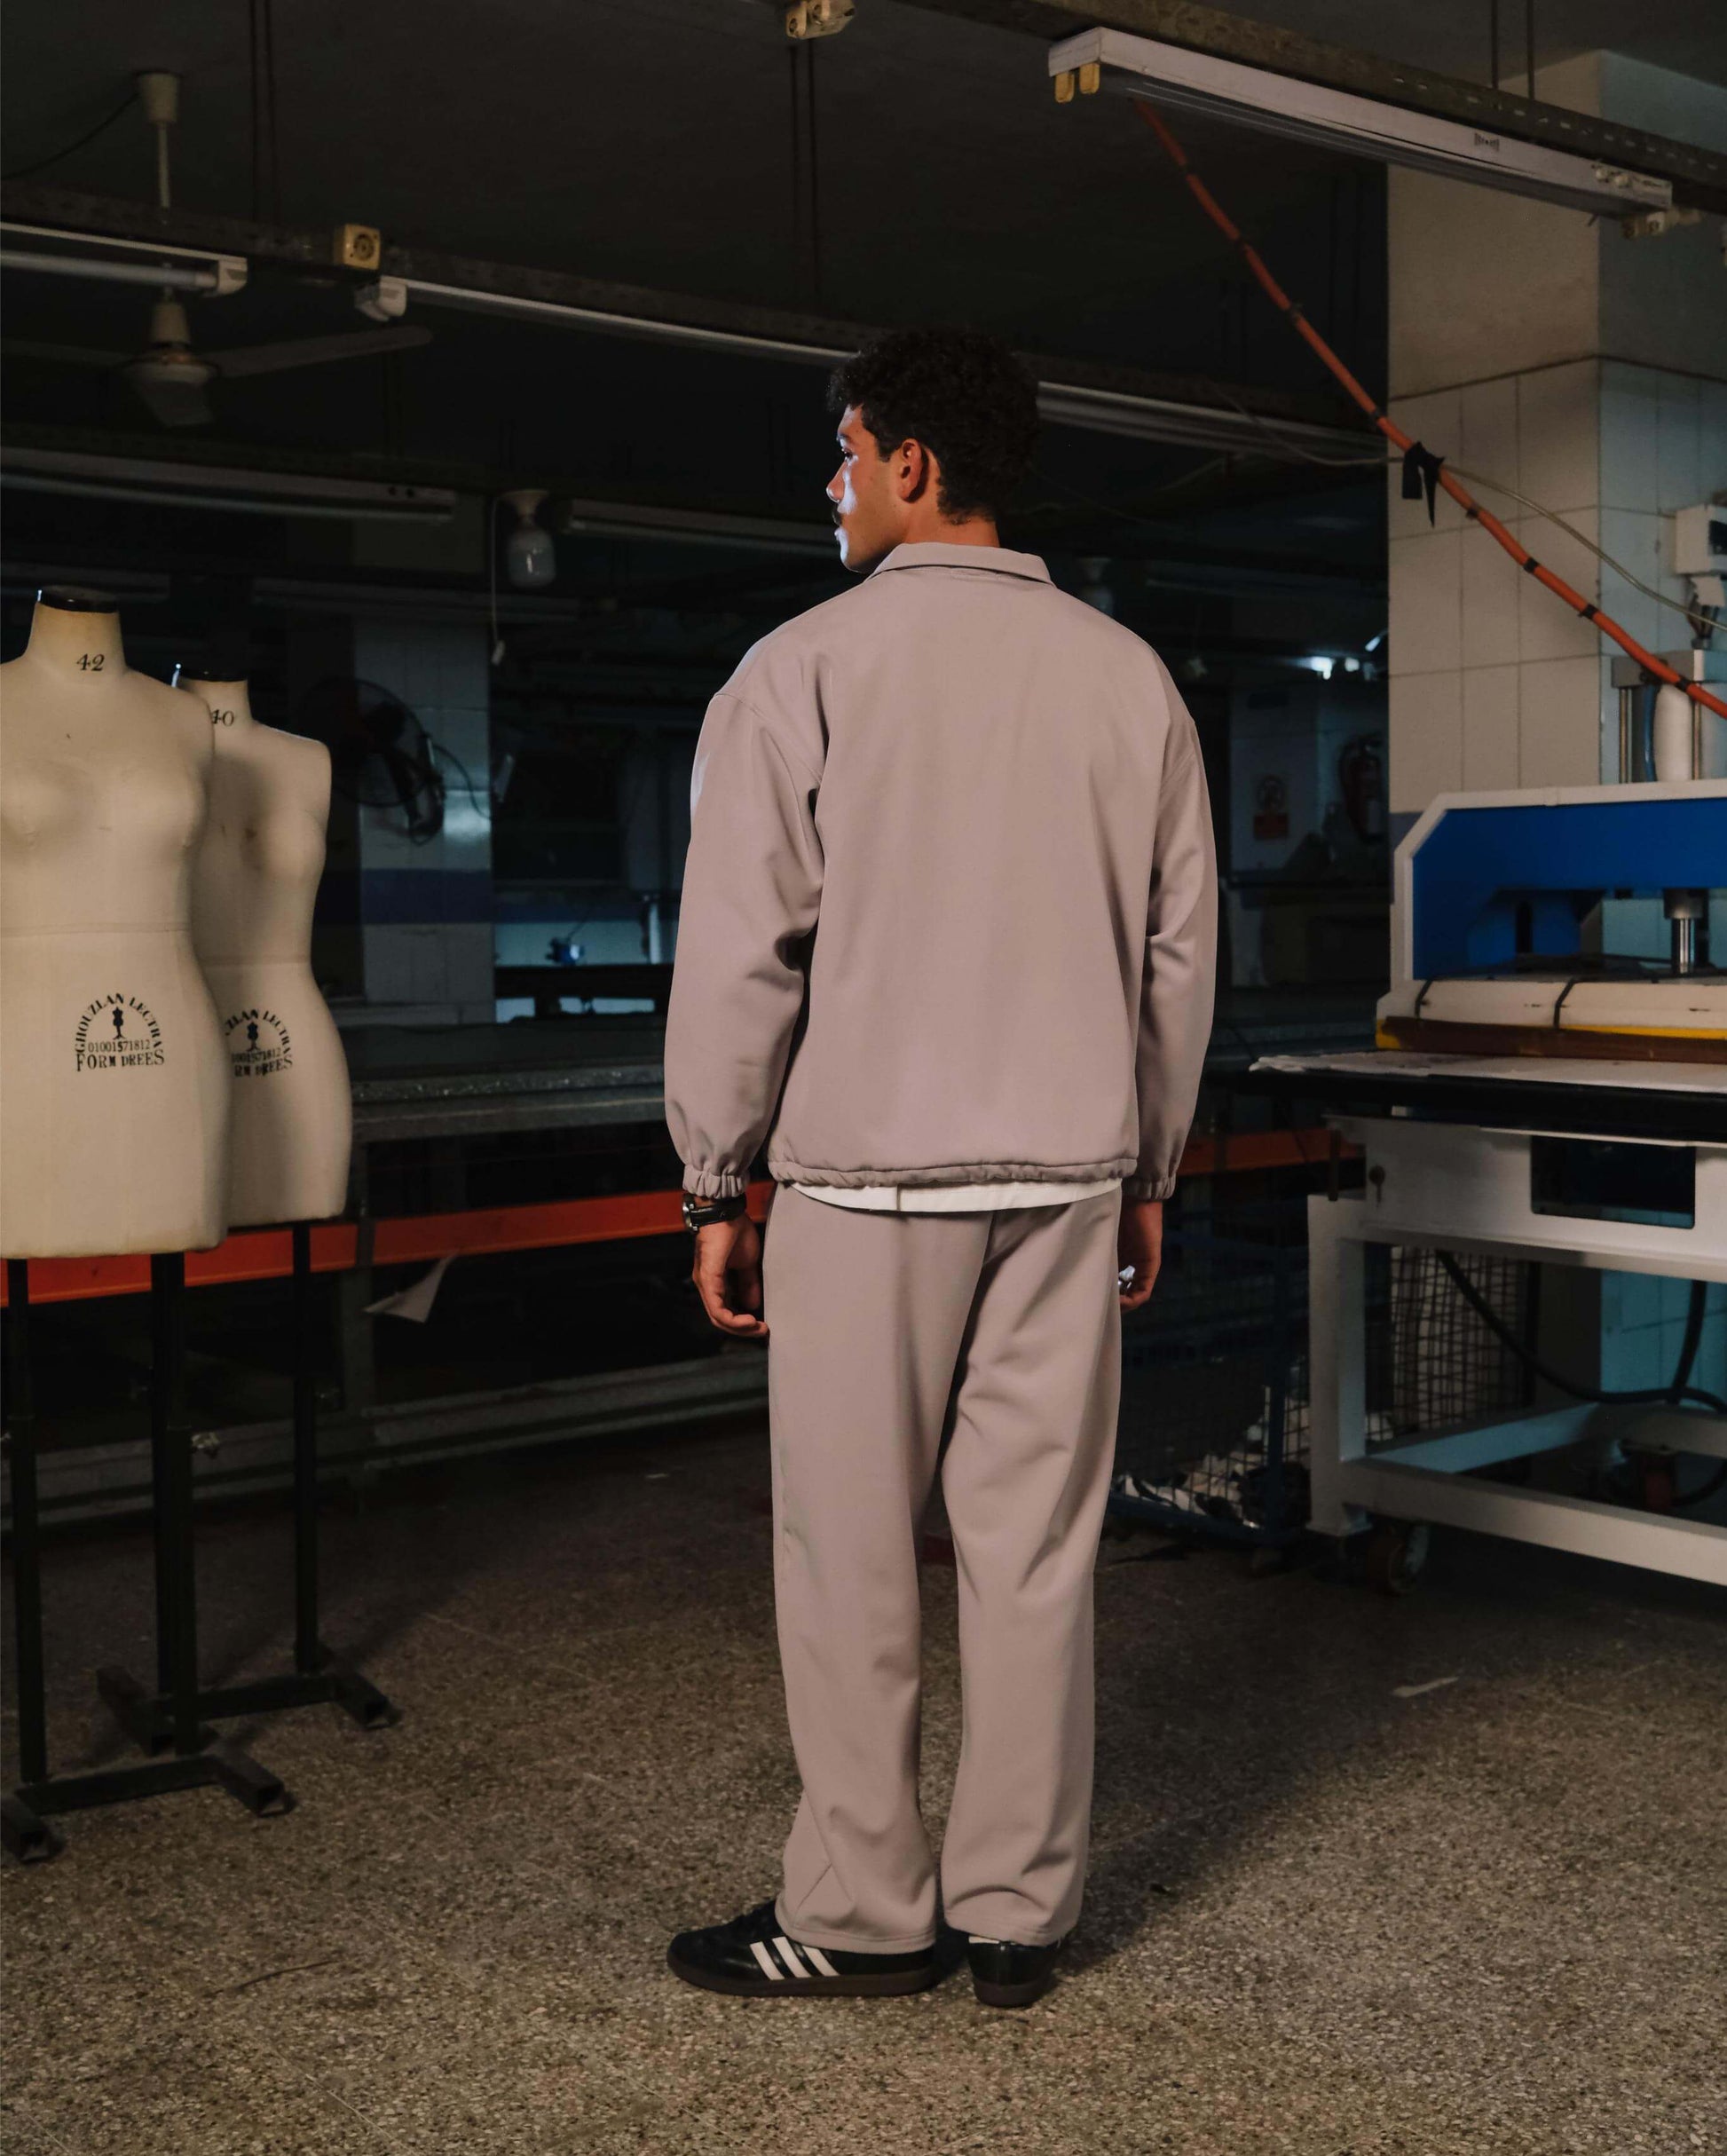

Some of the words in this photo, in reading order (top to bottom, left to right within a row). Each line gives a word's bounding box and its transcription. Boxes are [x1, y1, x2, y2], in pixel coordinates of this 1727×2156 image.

[76, 653, 106, 672] 42
[210, 708, 235, 727] 40
[75, 992, 124, 1053] GHOUZLAN
[129, 997, 162, 1048] LECTRA
[263, 1010, 291, 1054] LECTRA
[88, 1039, 150, 1053] 01001571812
[76, 1053, 116, 1072] FORM
[121, 1048, 165, 1067] DREES
